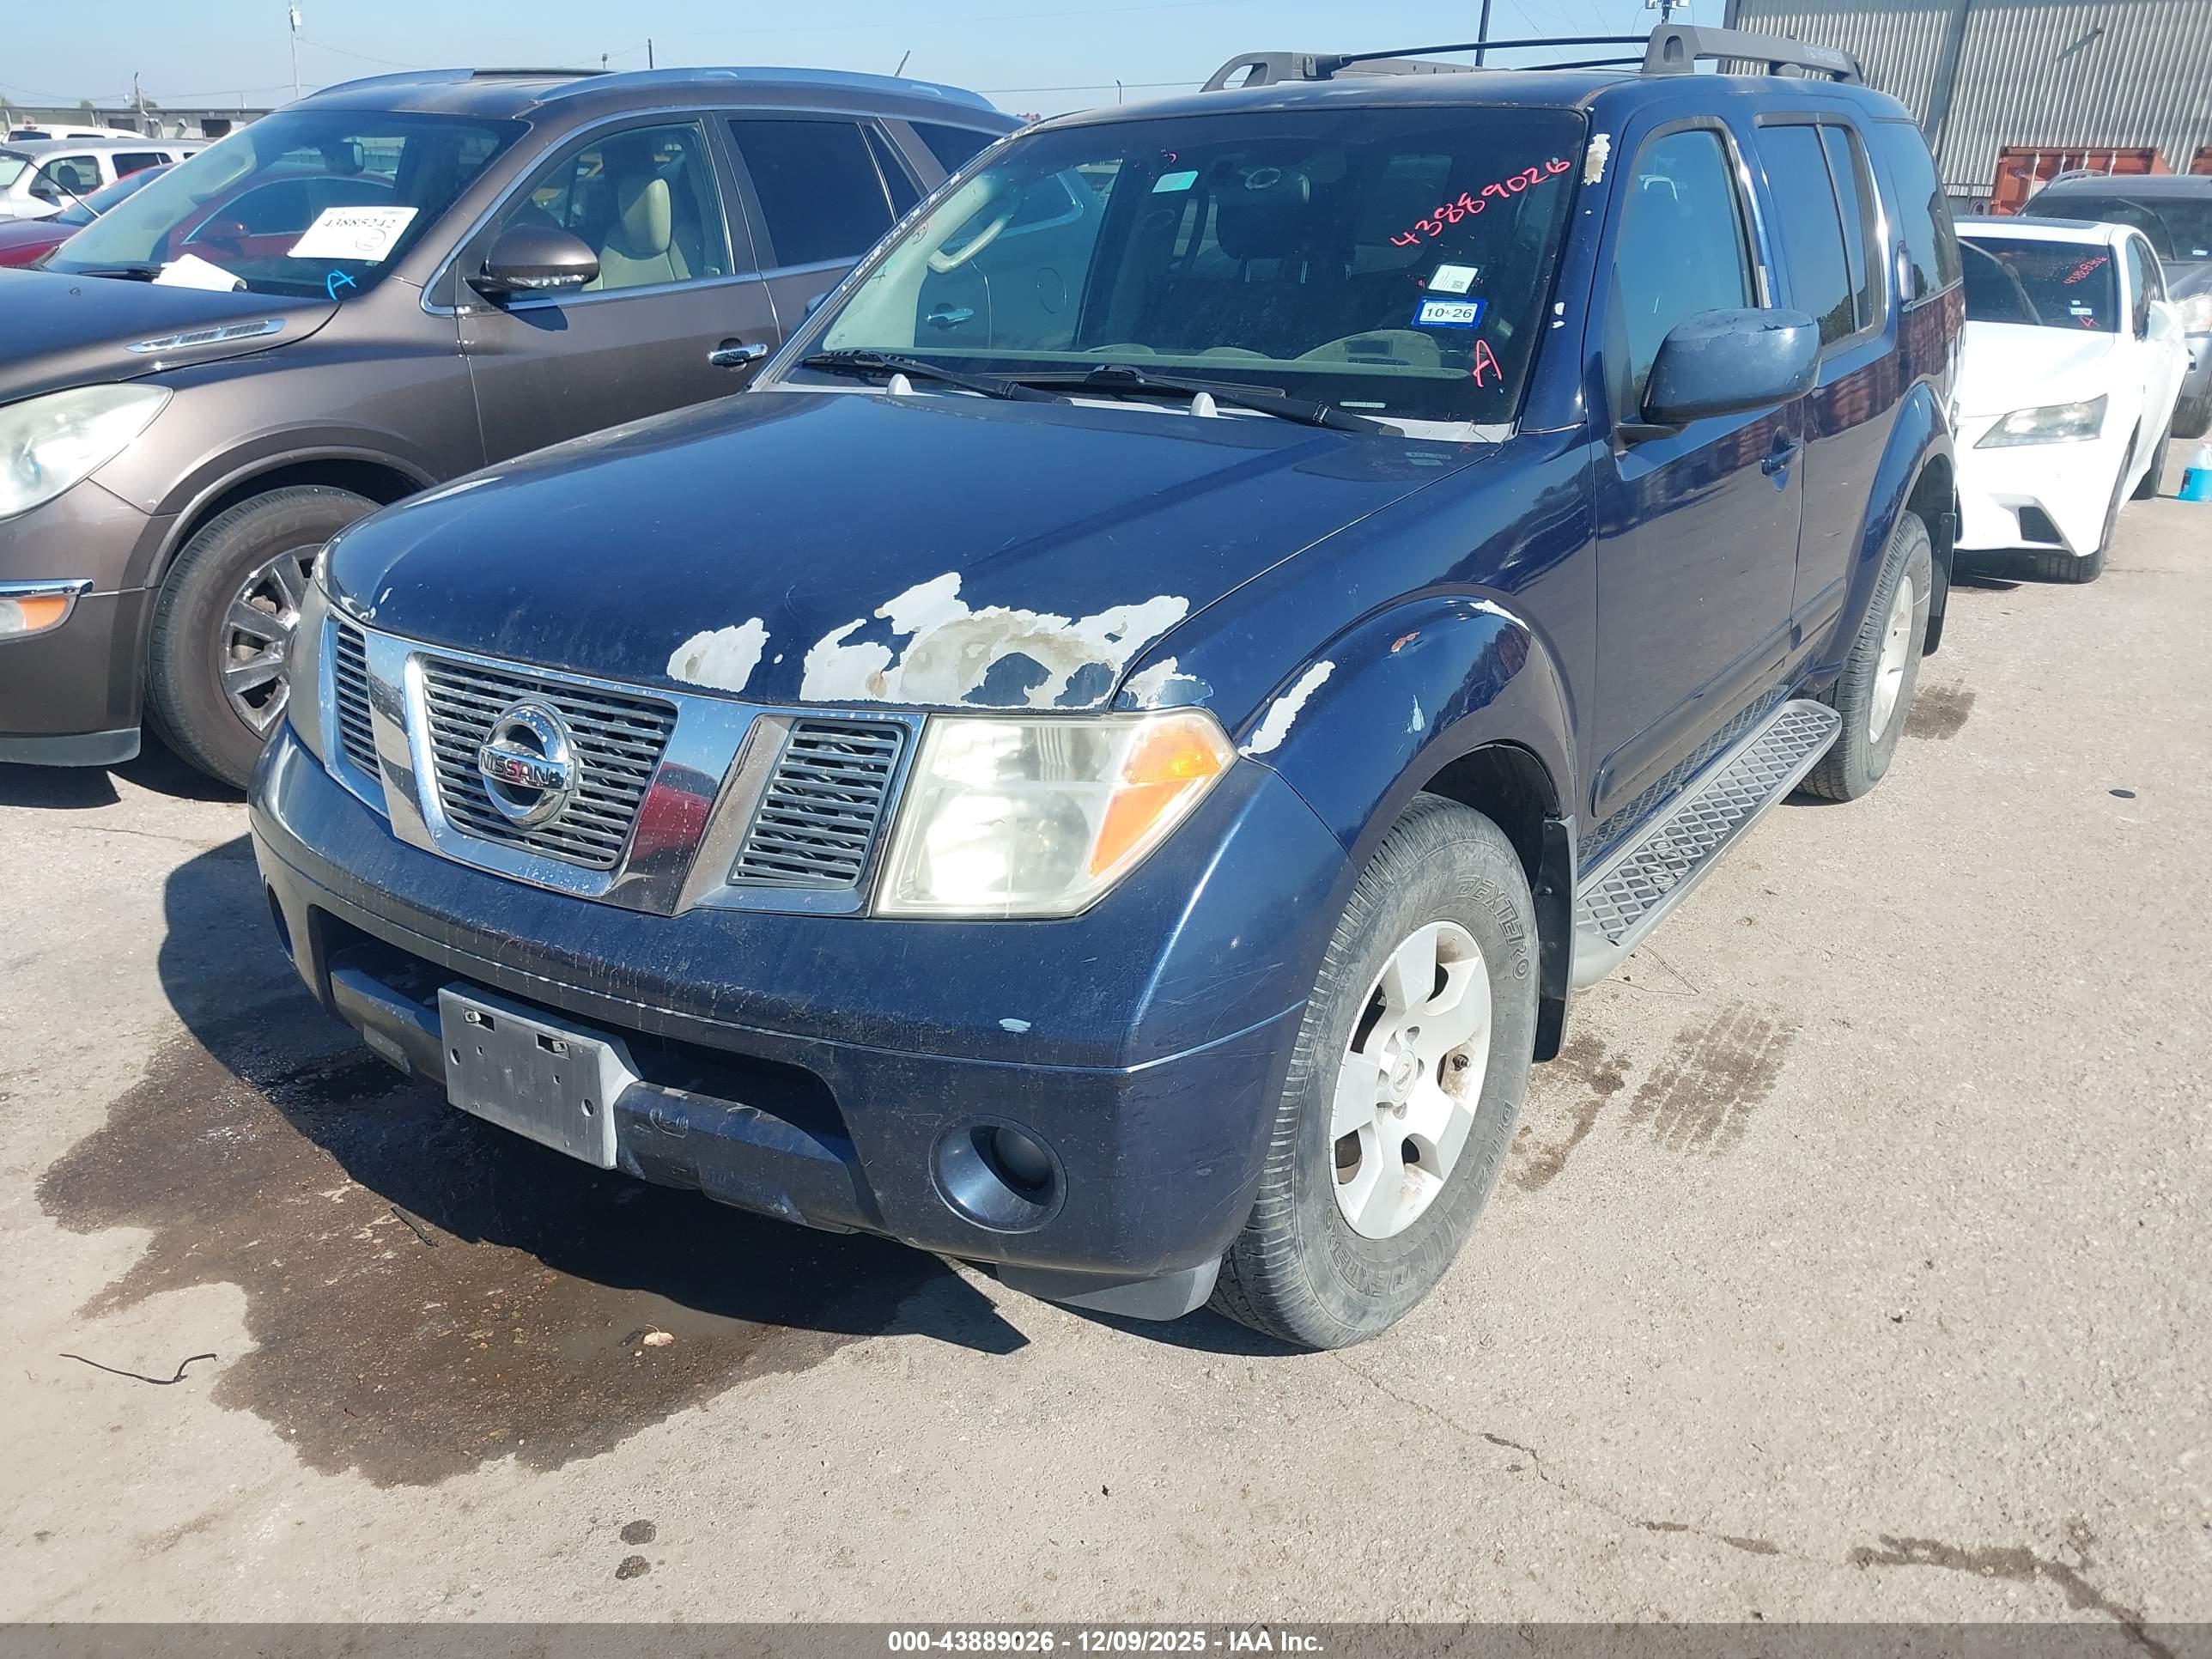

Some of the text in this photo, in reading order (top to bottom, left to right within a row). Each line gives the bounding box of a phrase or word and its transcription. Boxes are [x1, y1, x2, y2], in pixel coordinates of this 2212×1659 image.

[1390, 159, 1571, 246] 43889026
[326, 270, 356, 301] A
[1472, 339, 1503, 387] A
[480, 750, 550, 785] NISSAN
